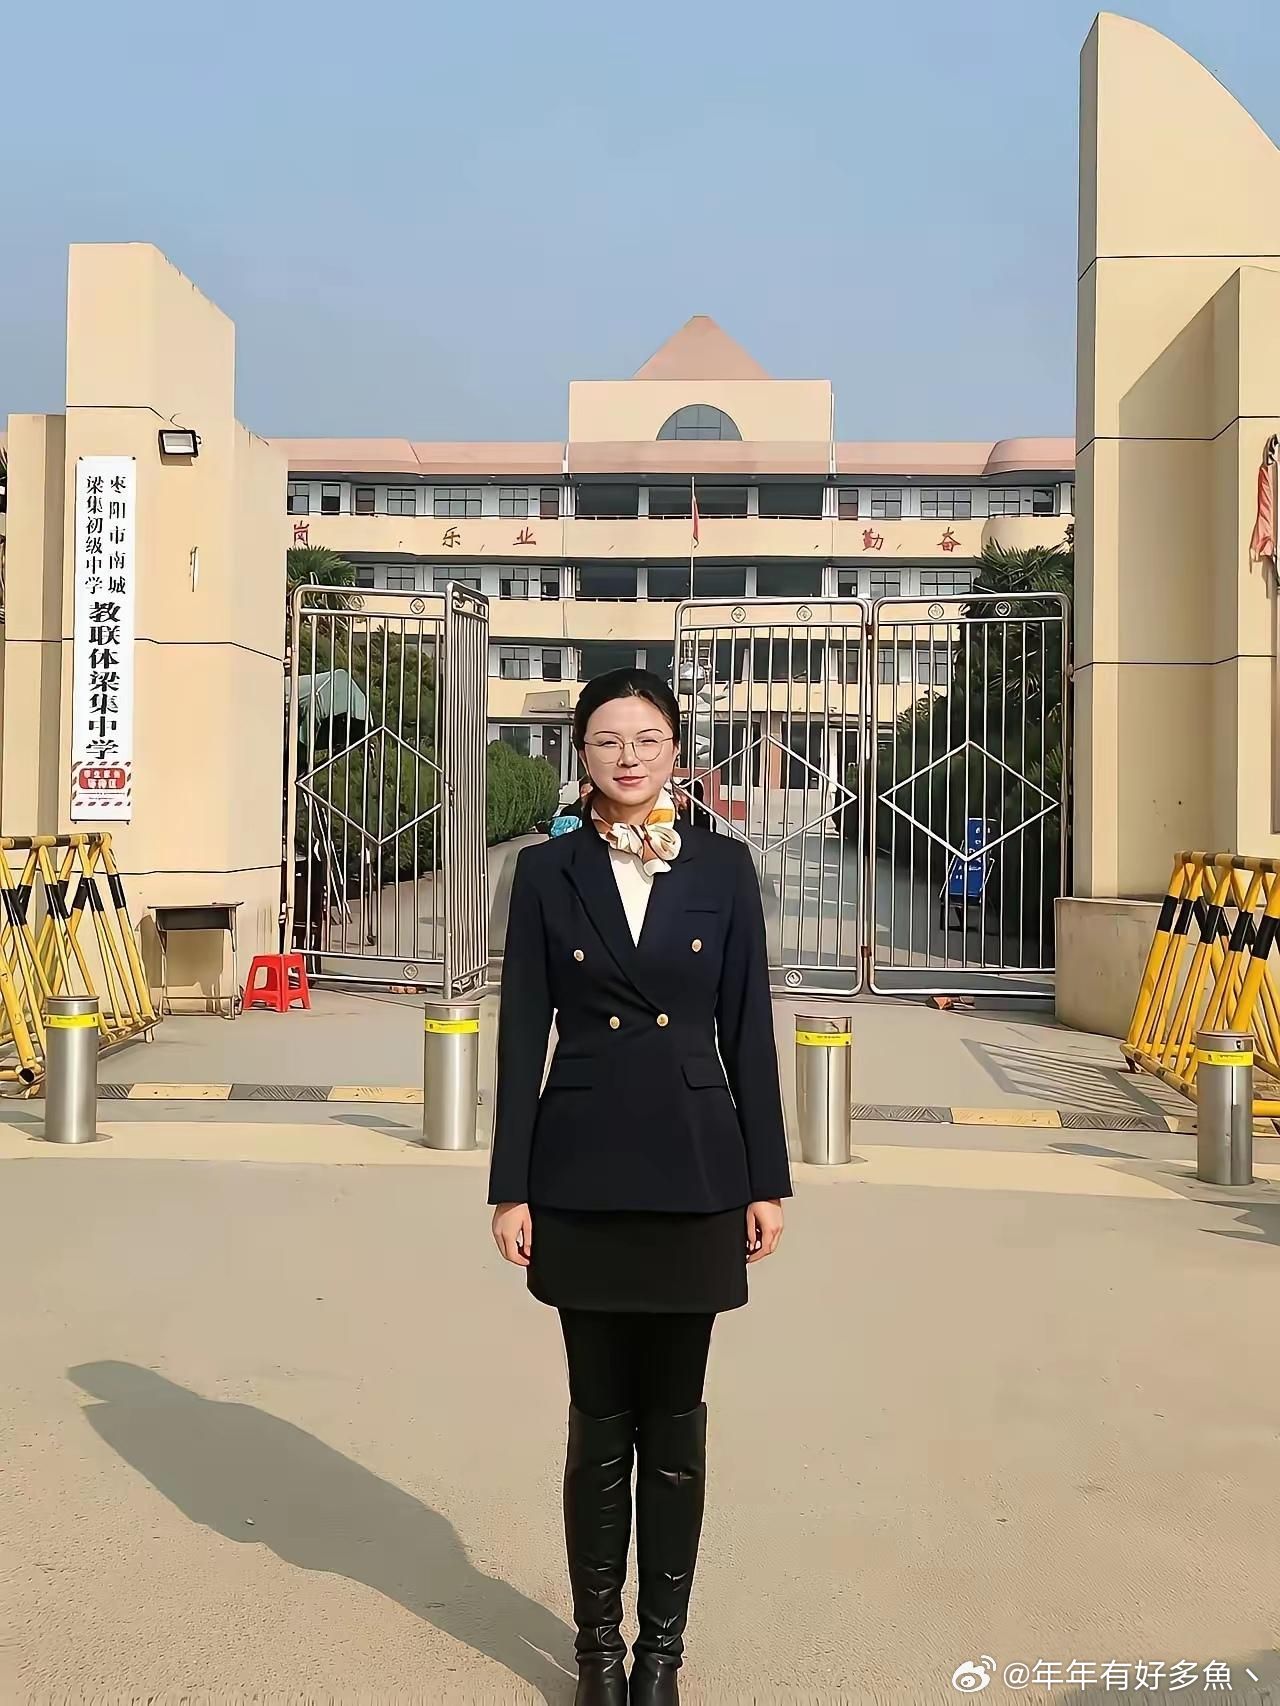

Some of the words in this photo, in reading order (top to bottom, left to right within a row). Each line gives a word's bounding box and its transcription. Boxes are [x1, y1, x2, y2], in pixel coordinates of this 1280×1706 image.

[85, 475, 104, 595] 梁集初级中学
[108, 475, 127, 595] 枣阳市南城
[442, 525, 537, 549] 乐业
[85, 601, 122, 760] 教联体梁集中学
